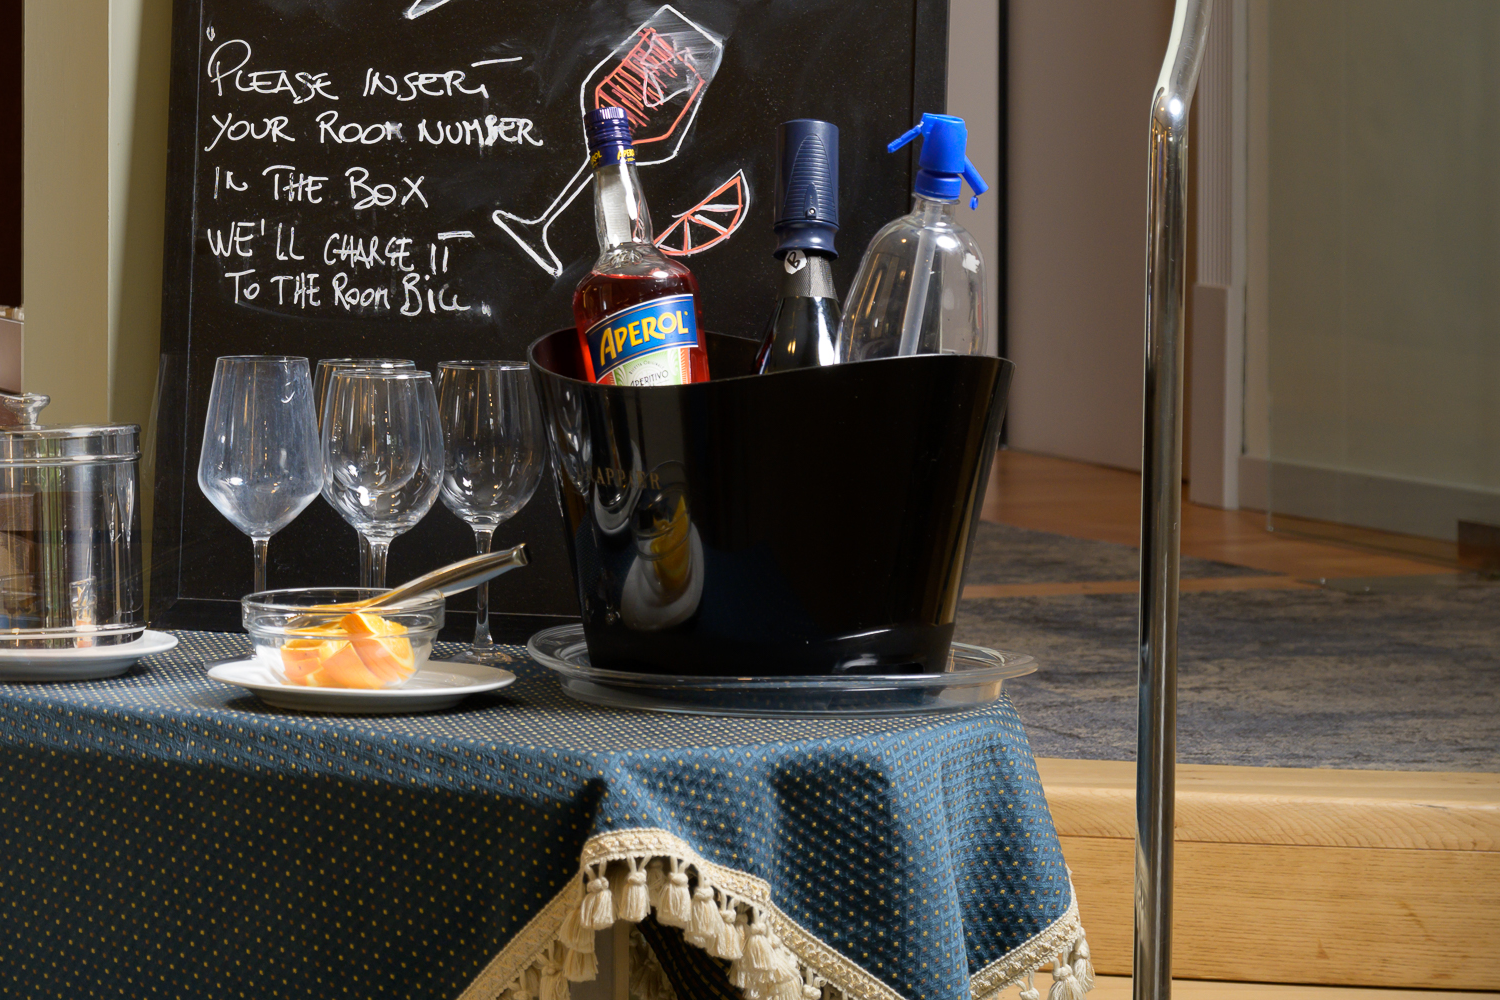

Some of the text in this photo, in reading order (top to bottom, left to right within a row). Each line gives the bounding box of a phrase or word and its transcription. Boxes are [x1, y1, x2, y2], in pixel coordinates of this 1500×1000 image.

[362, 55, 523, 102] INSERT
[204, 110, 544, 152] YOUR ROOM NUMBER
[262, 165, 329, 204] THE
[344, 166, 429, 210] BOX
[207, 218, 476, 275] WE'LL CHARGE IT
[270, 272, 322, 310] THE
[331, 271, 391, 311] ROOM
[599, 310, 689, 367] APEROL
